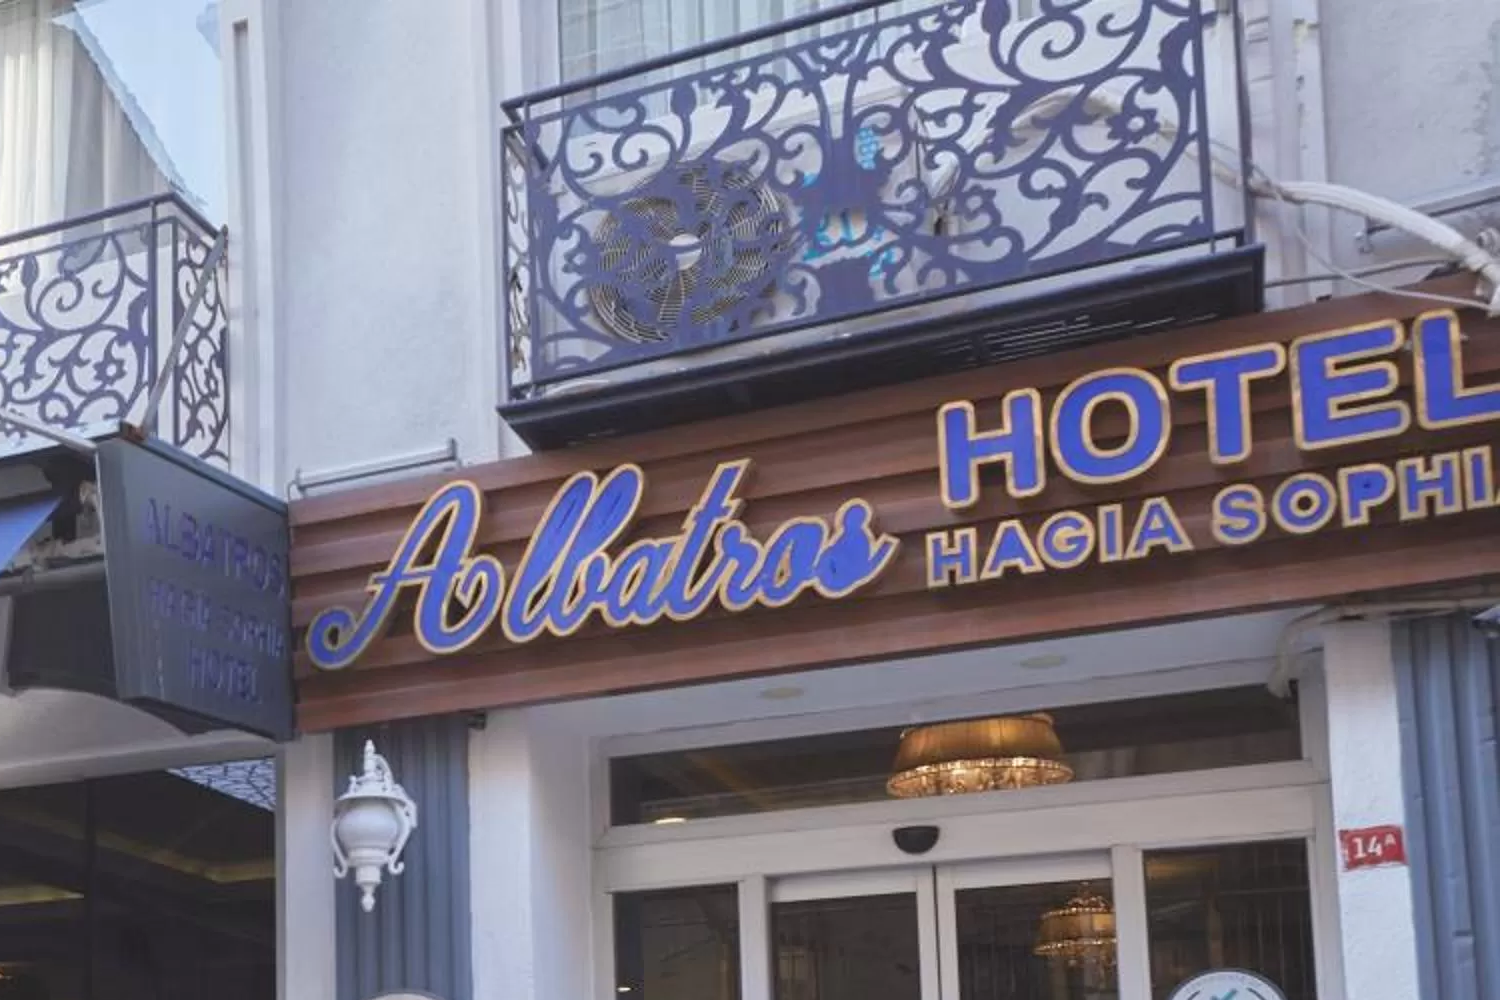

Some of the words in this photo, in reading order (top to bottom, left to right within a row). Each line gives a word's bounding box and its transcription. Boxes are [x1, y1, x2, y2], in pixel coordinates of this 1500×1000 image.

[937, 309, 1500, 509] HOTEL
[306, 459, 898, 670] Albatros
[926, 497, 1193, 588] HAGIA
[1212, 445, 1500, 546] SOPHI
